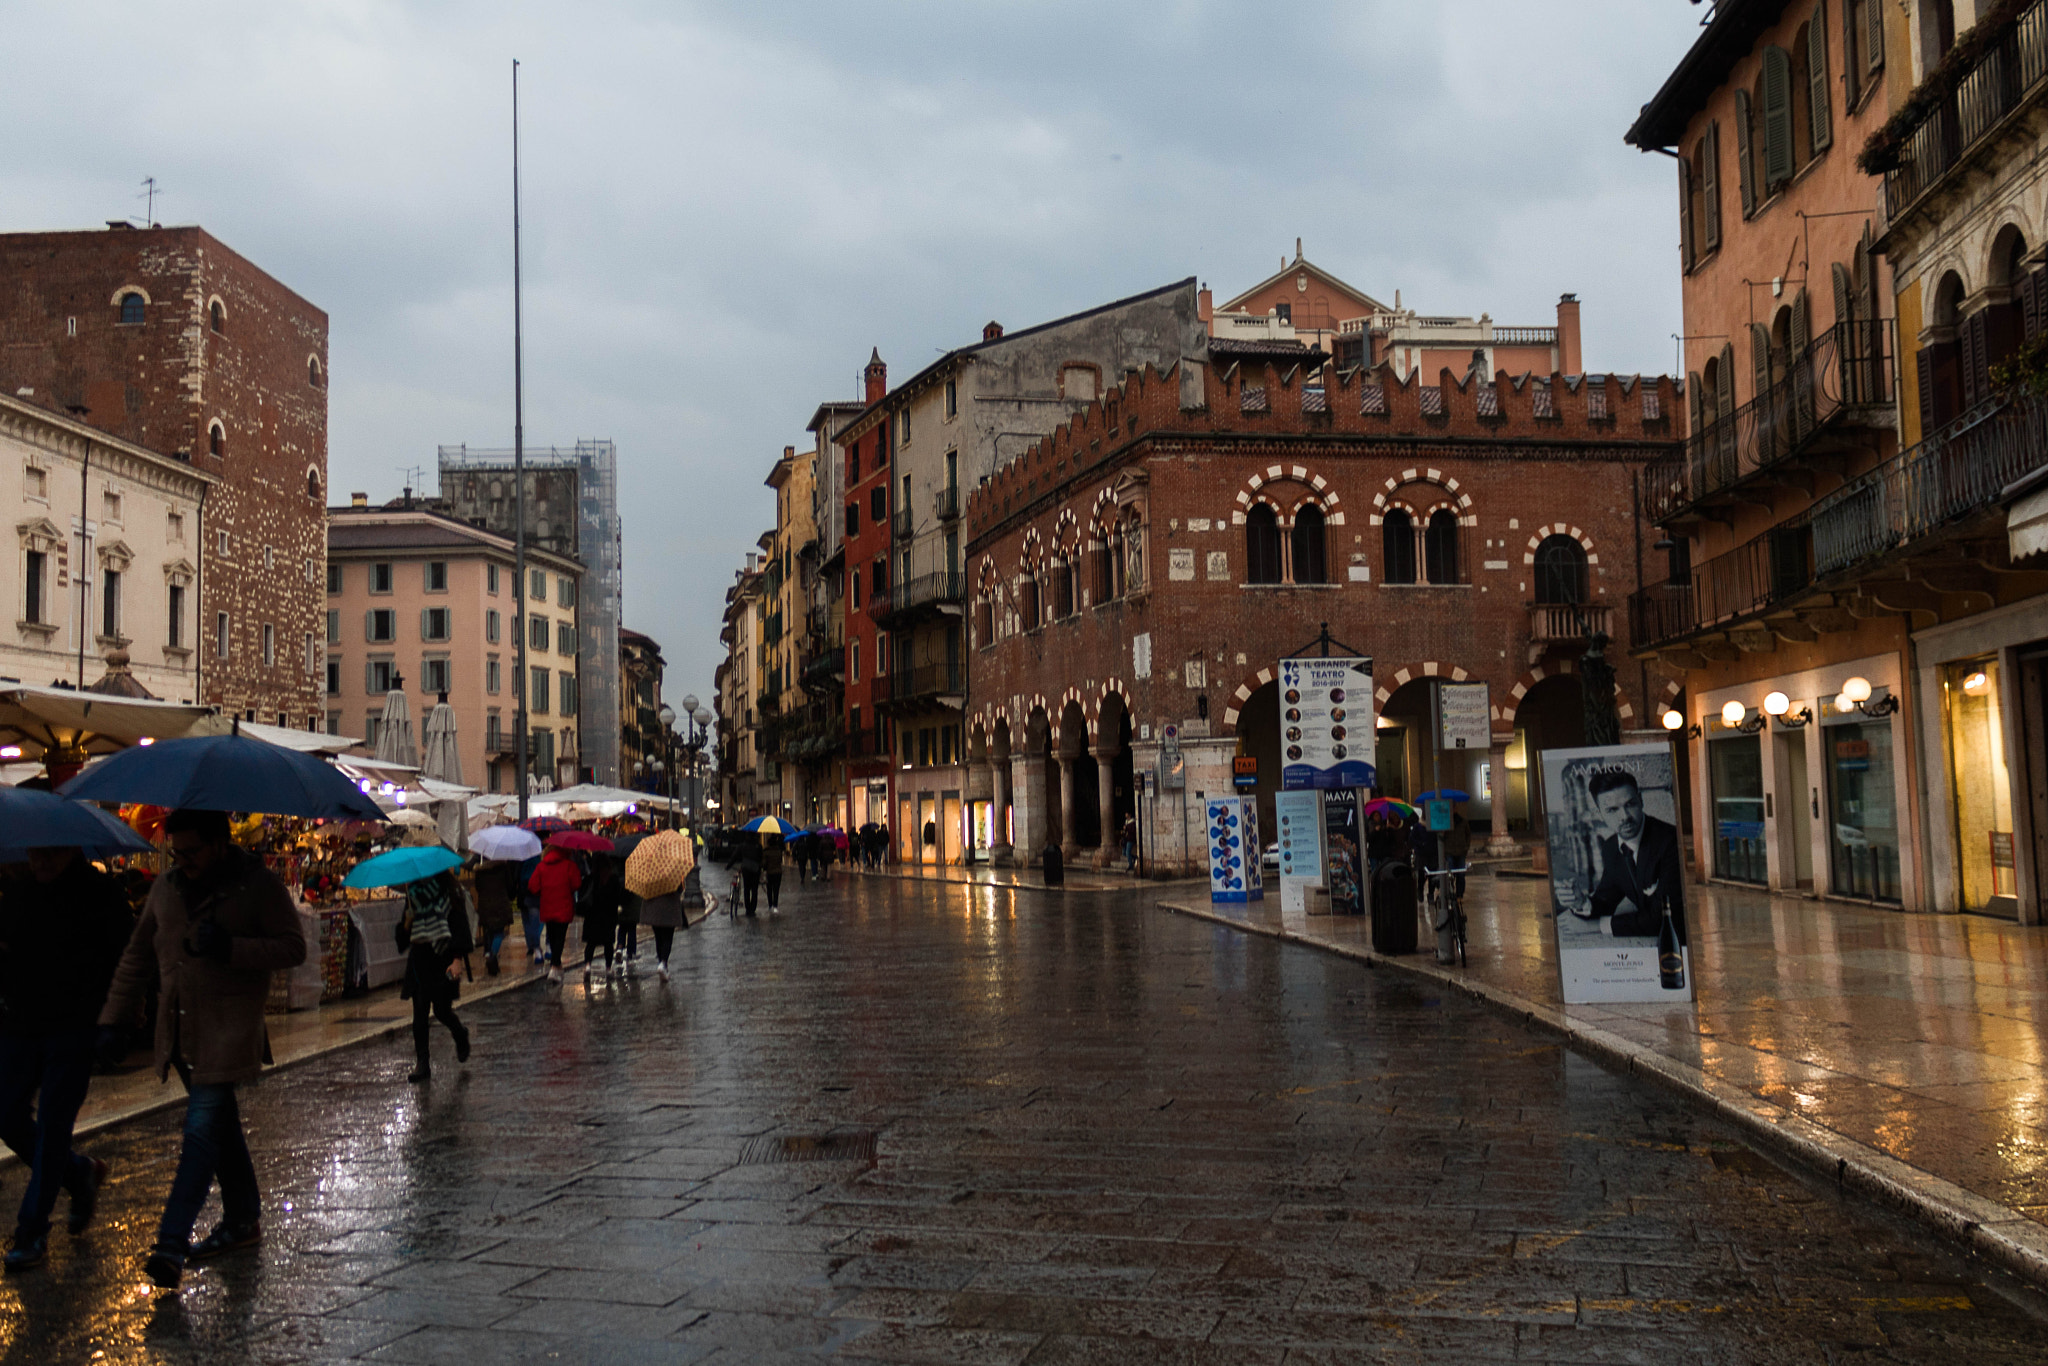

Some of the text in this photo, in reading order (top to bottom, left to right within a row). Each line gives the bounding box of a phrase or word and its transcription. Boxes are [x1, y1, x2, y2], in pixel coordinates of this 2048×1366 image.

[1304, 661, 1311, 669] IL
[1311, 670, 1345, 679] TEATRO
[1570, 760, 1644, 776] AMARONE
[1325, 790, 1355, 802] MAYA
